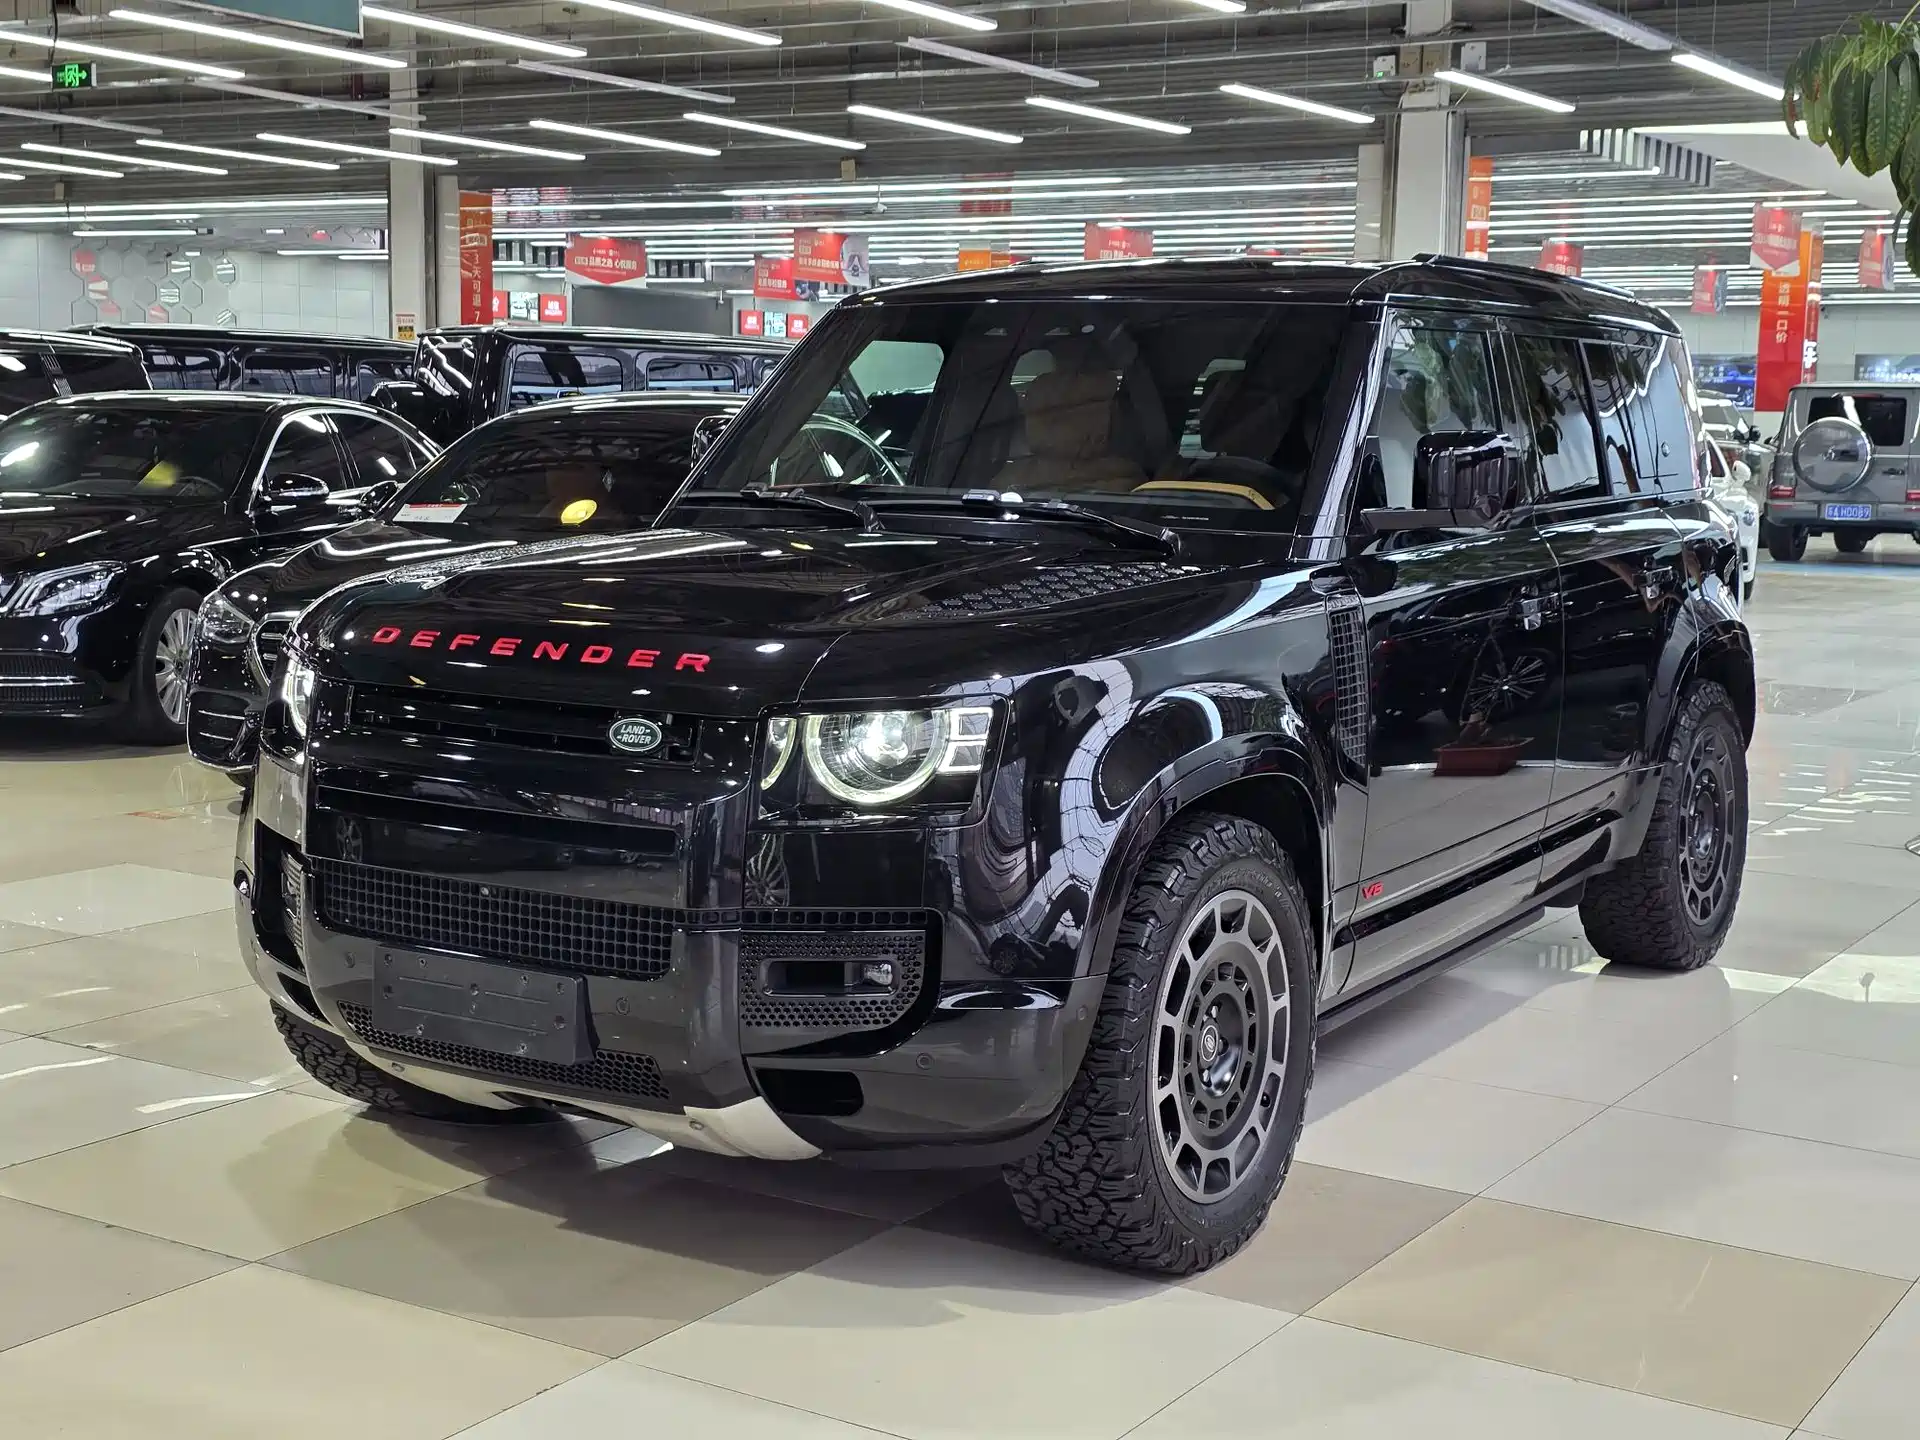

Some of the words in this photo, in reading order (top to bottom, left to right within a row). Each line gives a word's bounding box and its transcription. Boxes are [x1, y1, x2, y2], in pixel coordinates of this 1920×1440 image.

[1774, 281, 1791, 344] 透明一口价
[372, 627, 711, 673] DEFENDER
